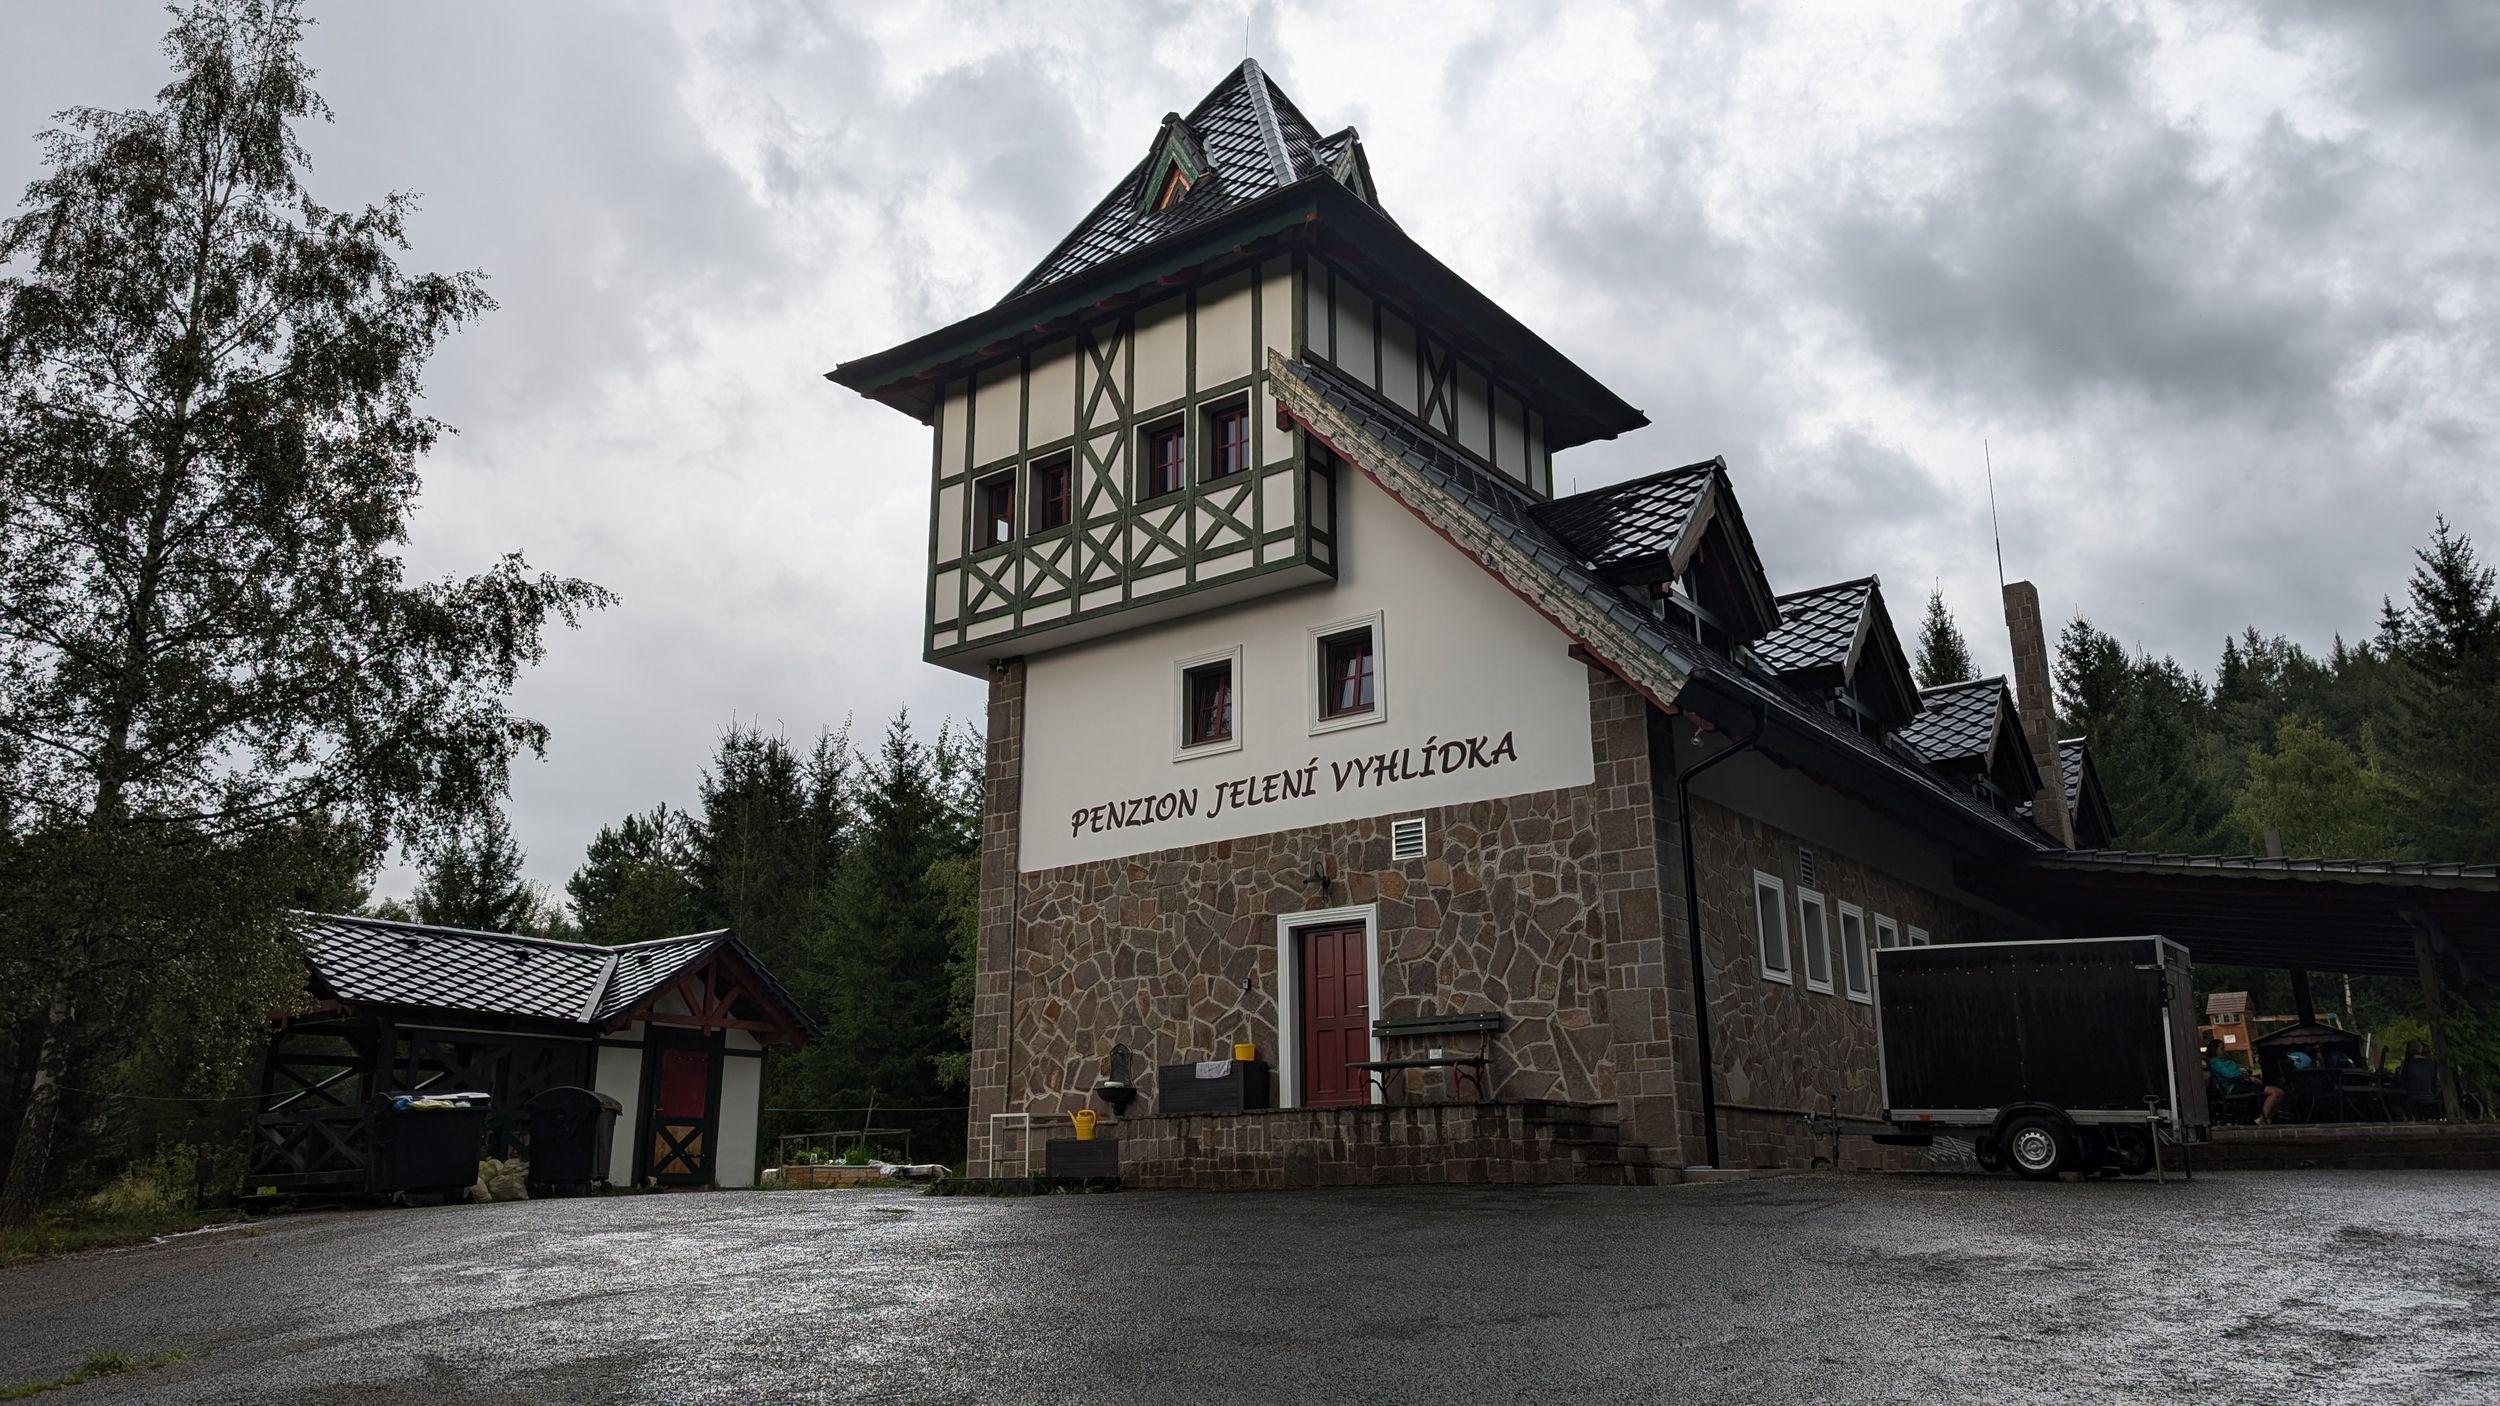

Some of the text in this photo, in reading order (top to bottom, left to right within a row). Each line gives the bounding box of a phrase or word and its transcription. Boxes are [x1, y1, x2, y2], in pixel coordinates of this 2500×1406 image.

[1071, 731, 1518, 838] PENZION JELENÍ VYHLÍDKA
